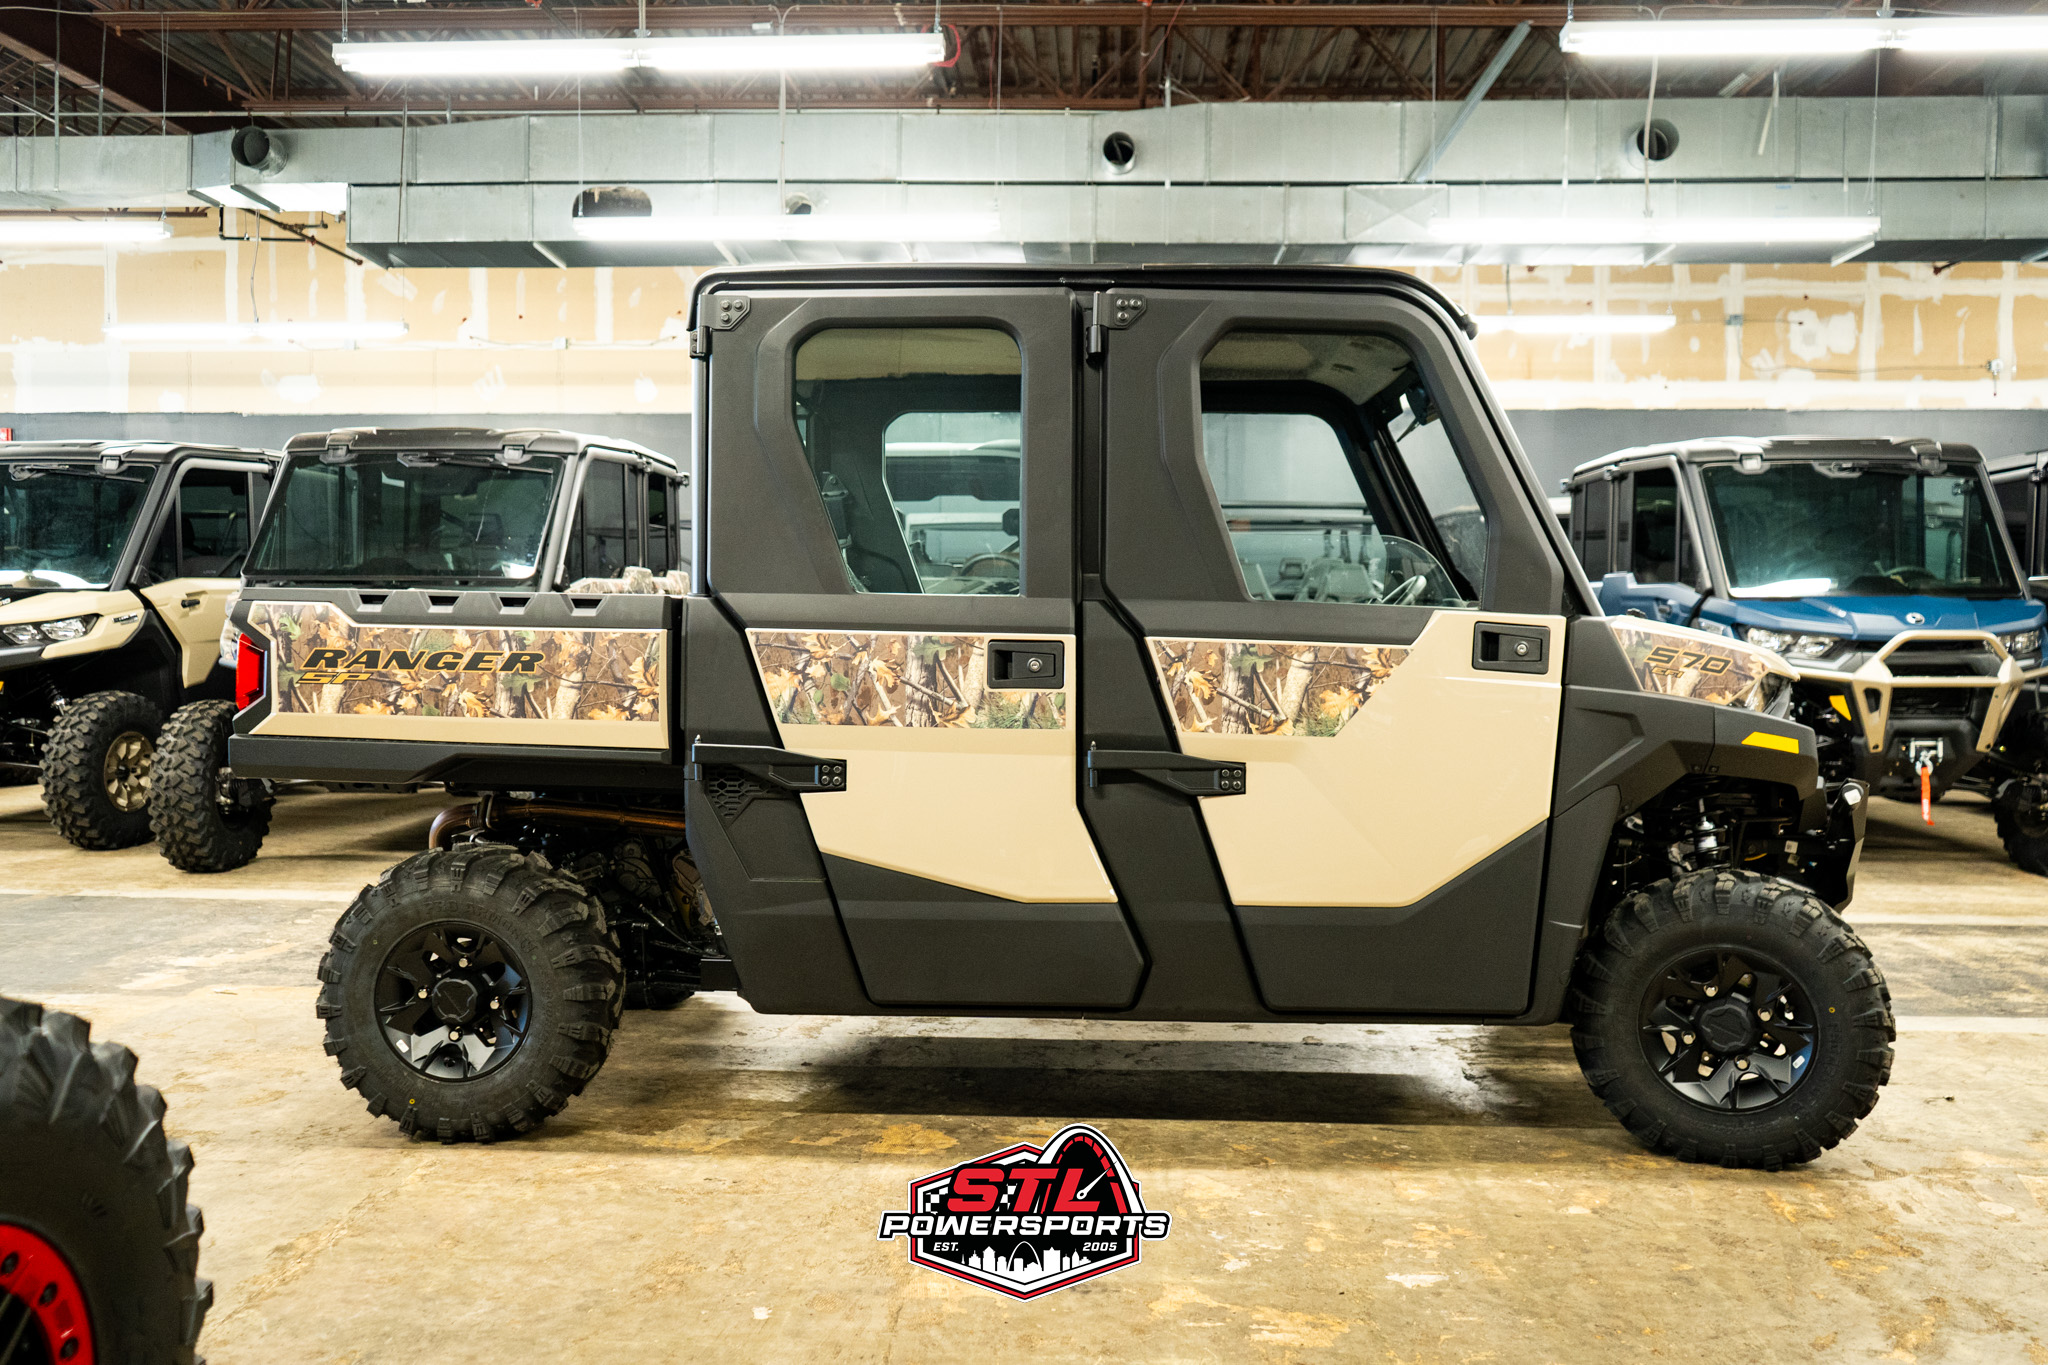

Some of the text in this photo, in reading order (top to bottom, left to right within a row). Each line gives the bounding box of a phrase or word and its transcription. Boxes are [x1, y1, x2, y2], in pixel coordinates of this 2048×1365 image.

[301, 648, 545, 673] RANGER
[1644, 645, 1733, 675] 570
[296, 672, 374, 684] SP
[1651, 666, 1684, 678] EFI
